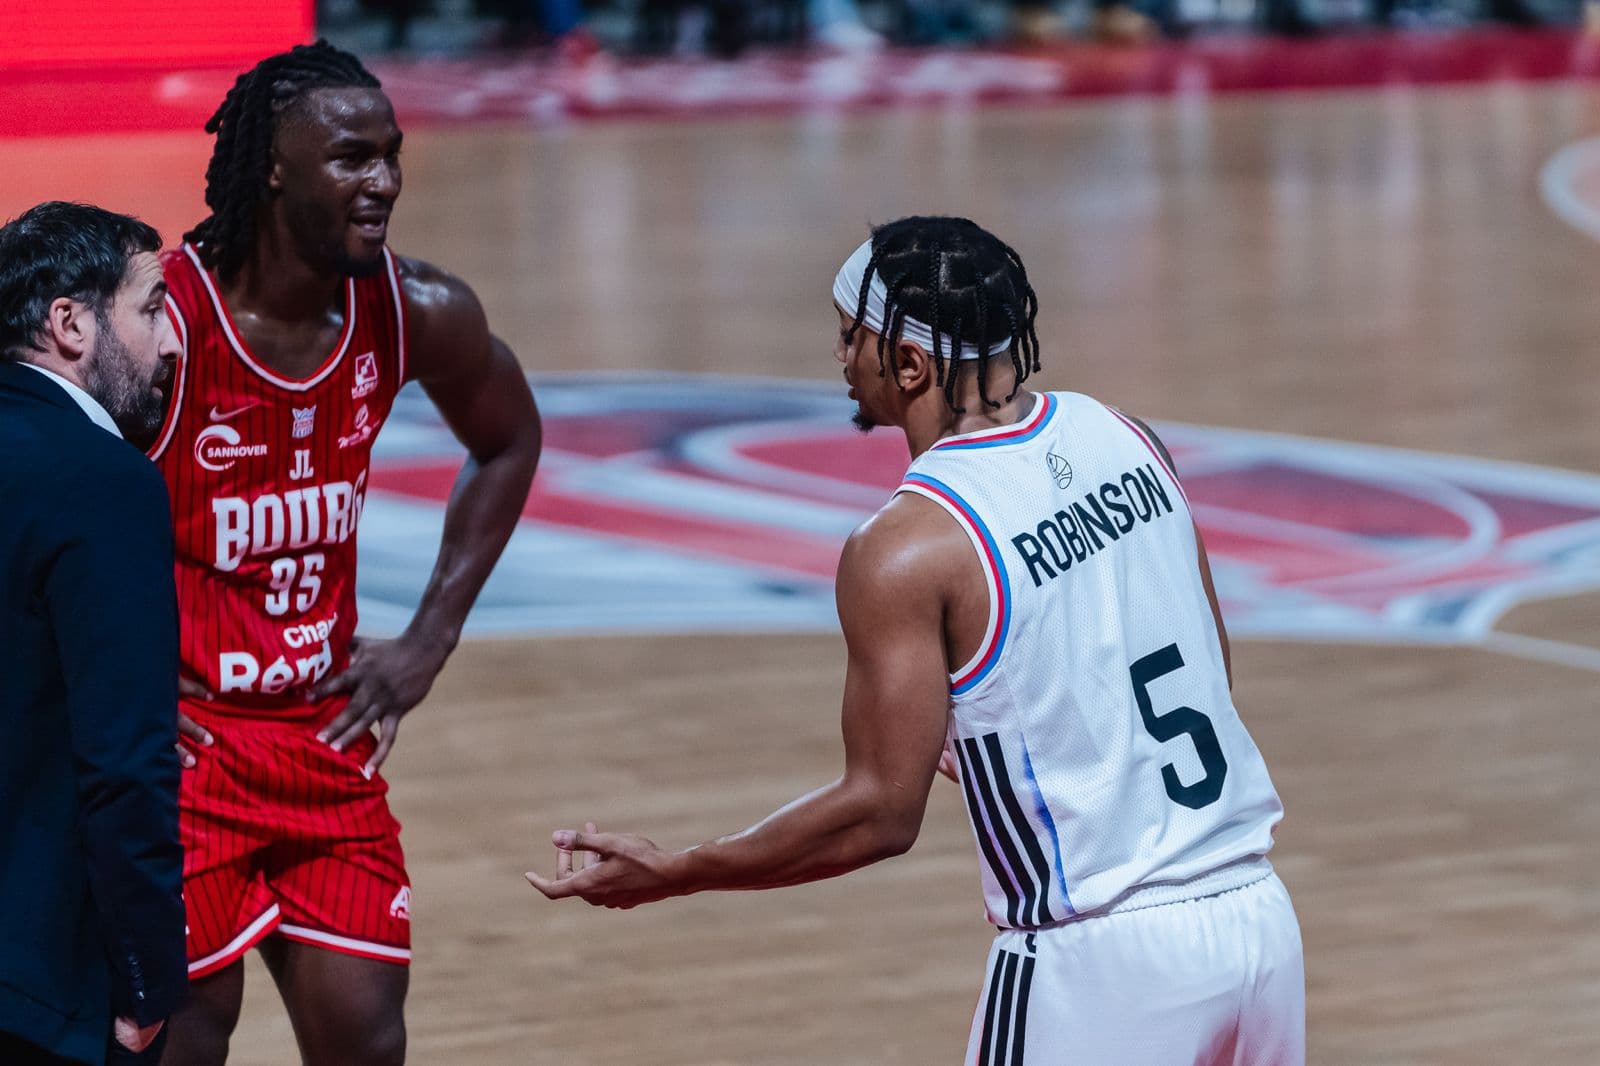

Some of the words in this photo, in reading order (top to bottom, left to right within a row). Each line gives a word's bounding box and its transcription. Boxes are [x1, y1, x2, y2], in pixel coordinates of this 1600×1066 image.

[206, 443, 269, 458] SANNOVER
[289, 448, 315, 481] JL
[1011, 463, 1174, 588] ROBINSON
[264, 552, 325, 616] 95
[1129, 641, 1228, 810] 5
